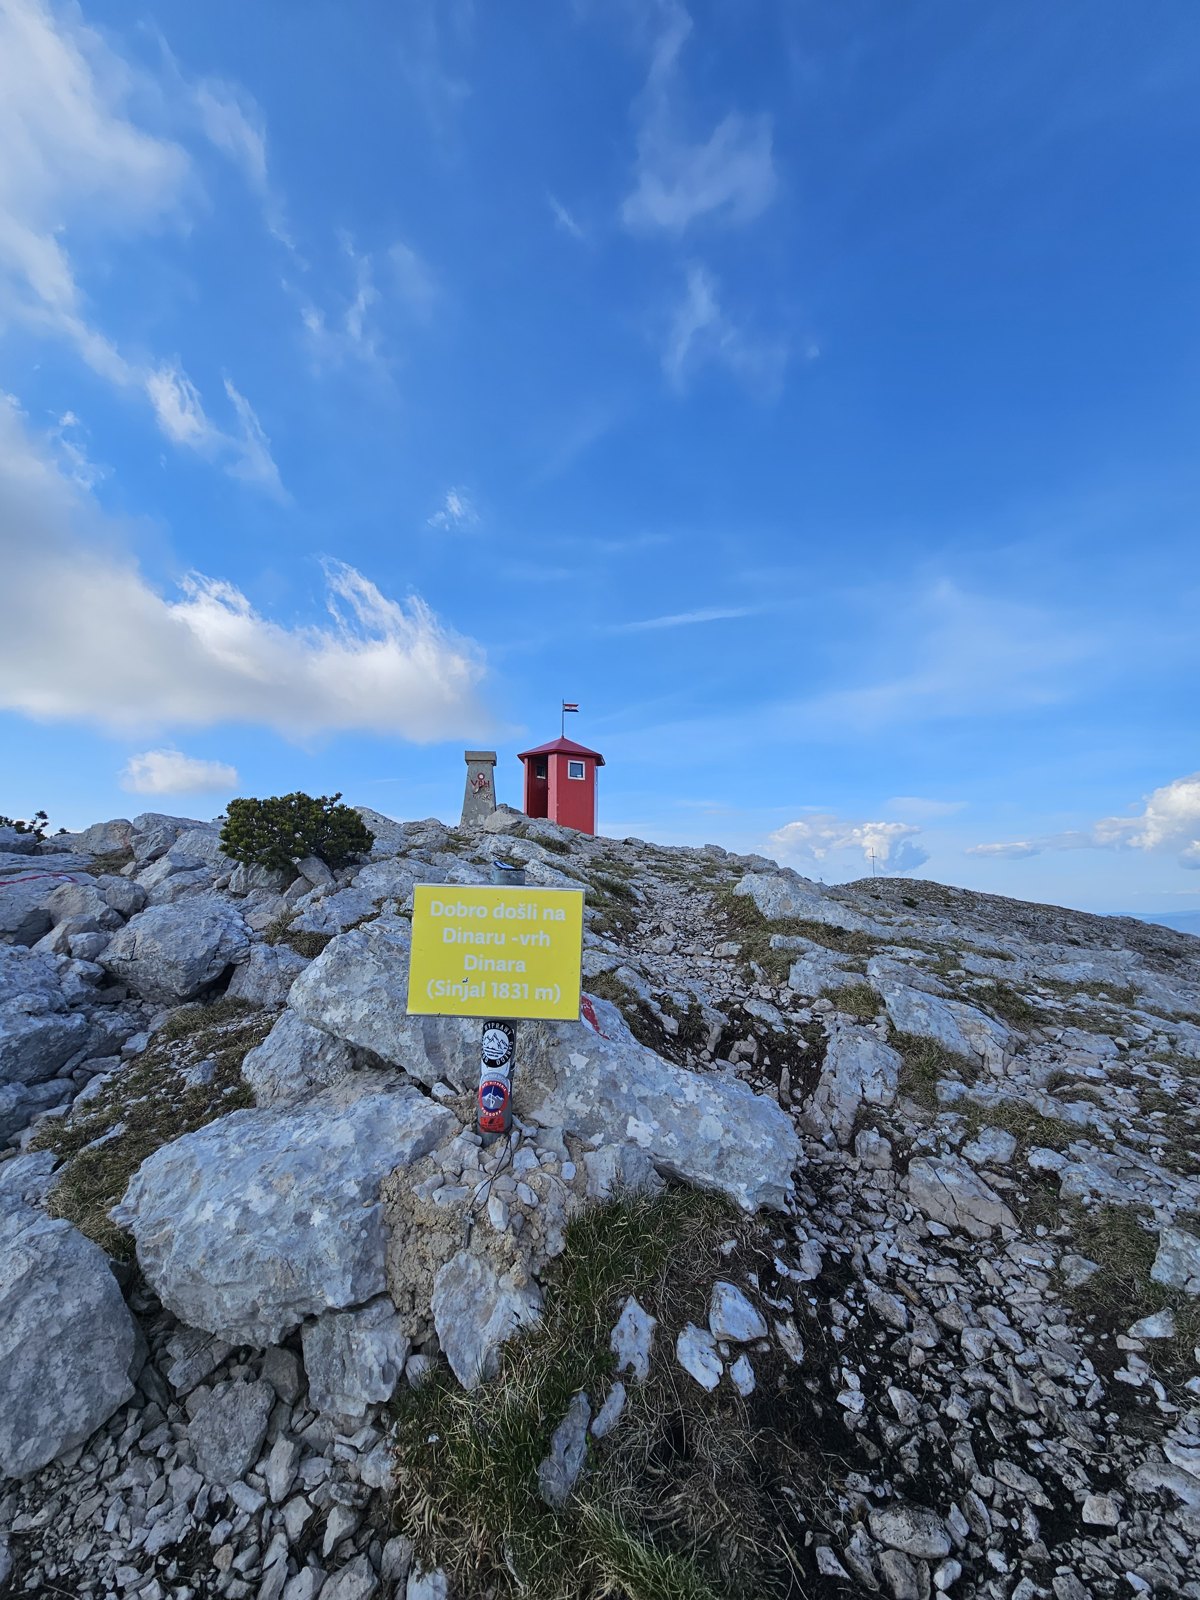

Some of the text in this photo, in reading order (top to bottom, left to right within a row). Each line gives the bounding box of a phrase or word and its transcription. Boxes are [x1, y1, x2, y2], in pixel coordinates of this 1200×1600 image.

[471, 780, 490, 788] VRH
[431, 901, 565, 921] Dobro došli na
[443, 927, 550, 947] Dinaru -vrh
[464, 954, 526, 972] Dinara
[427, 979, 561, 1004] (Sinjal 1831 m)
